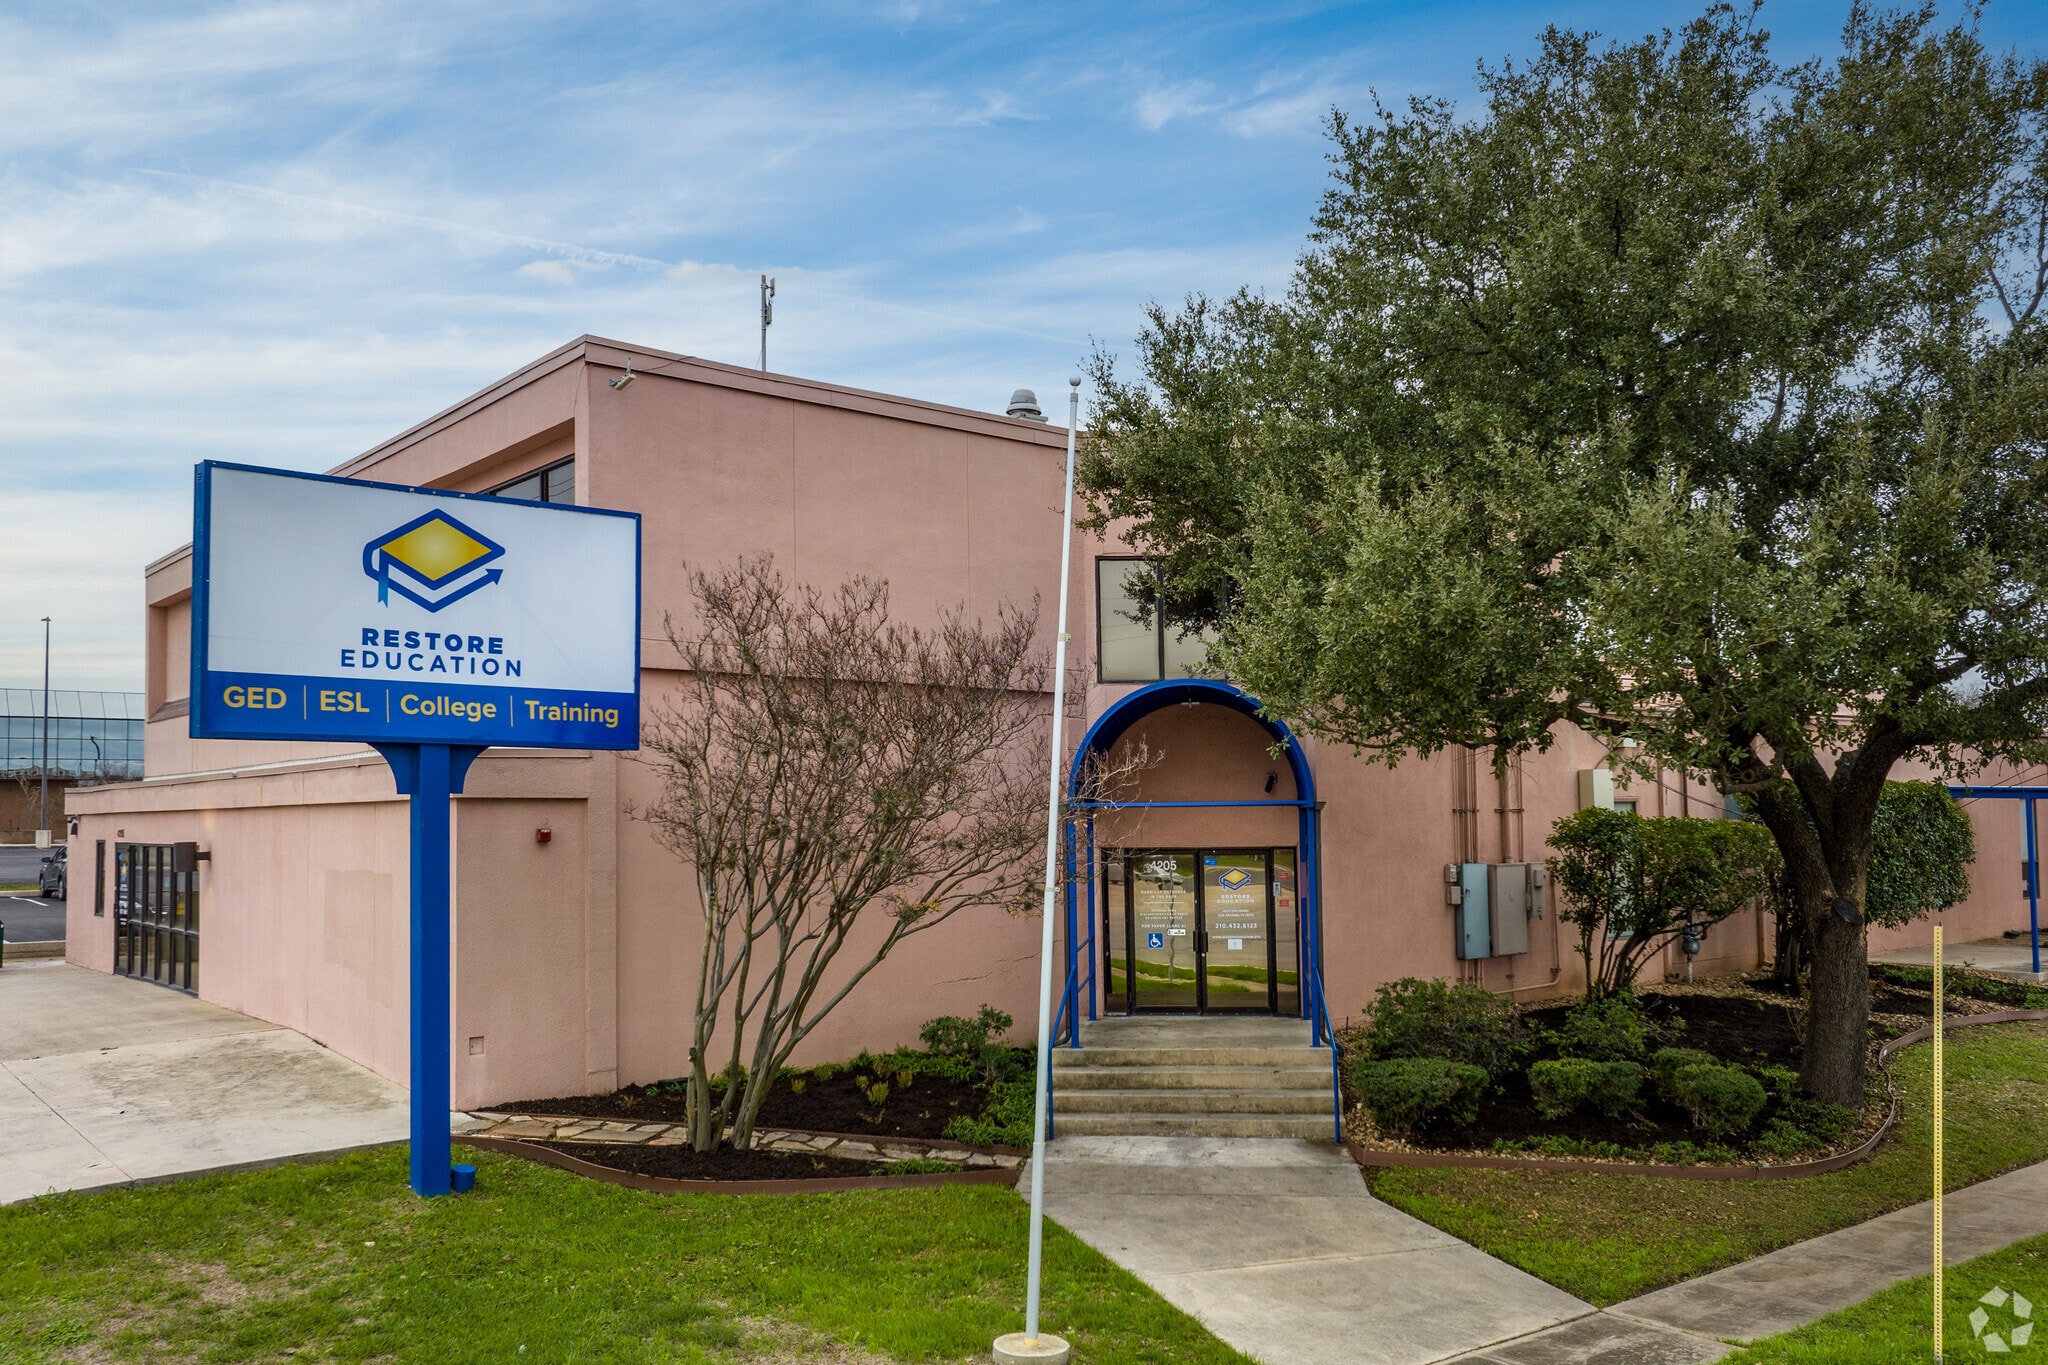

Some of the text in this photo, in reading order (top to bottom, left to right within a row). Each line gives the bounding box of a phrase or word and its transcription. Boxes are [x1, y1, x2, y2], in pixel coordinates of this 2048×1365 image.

[362, 627, 503, 655] RESTORE
[341, 648, 522, 677] EDUCATION
[223, 685, 619, 729] GED ESL College Training
[1150, 860, 1177, 871] 4205
